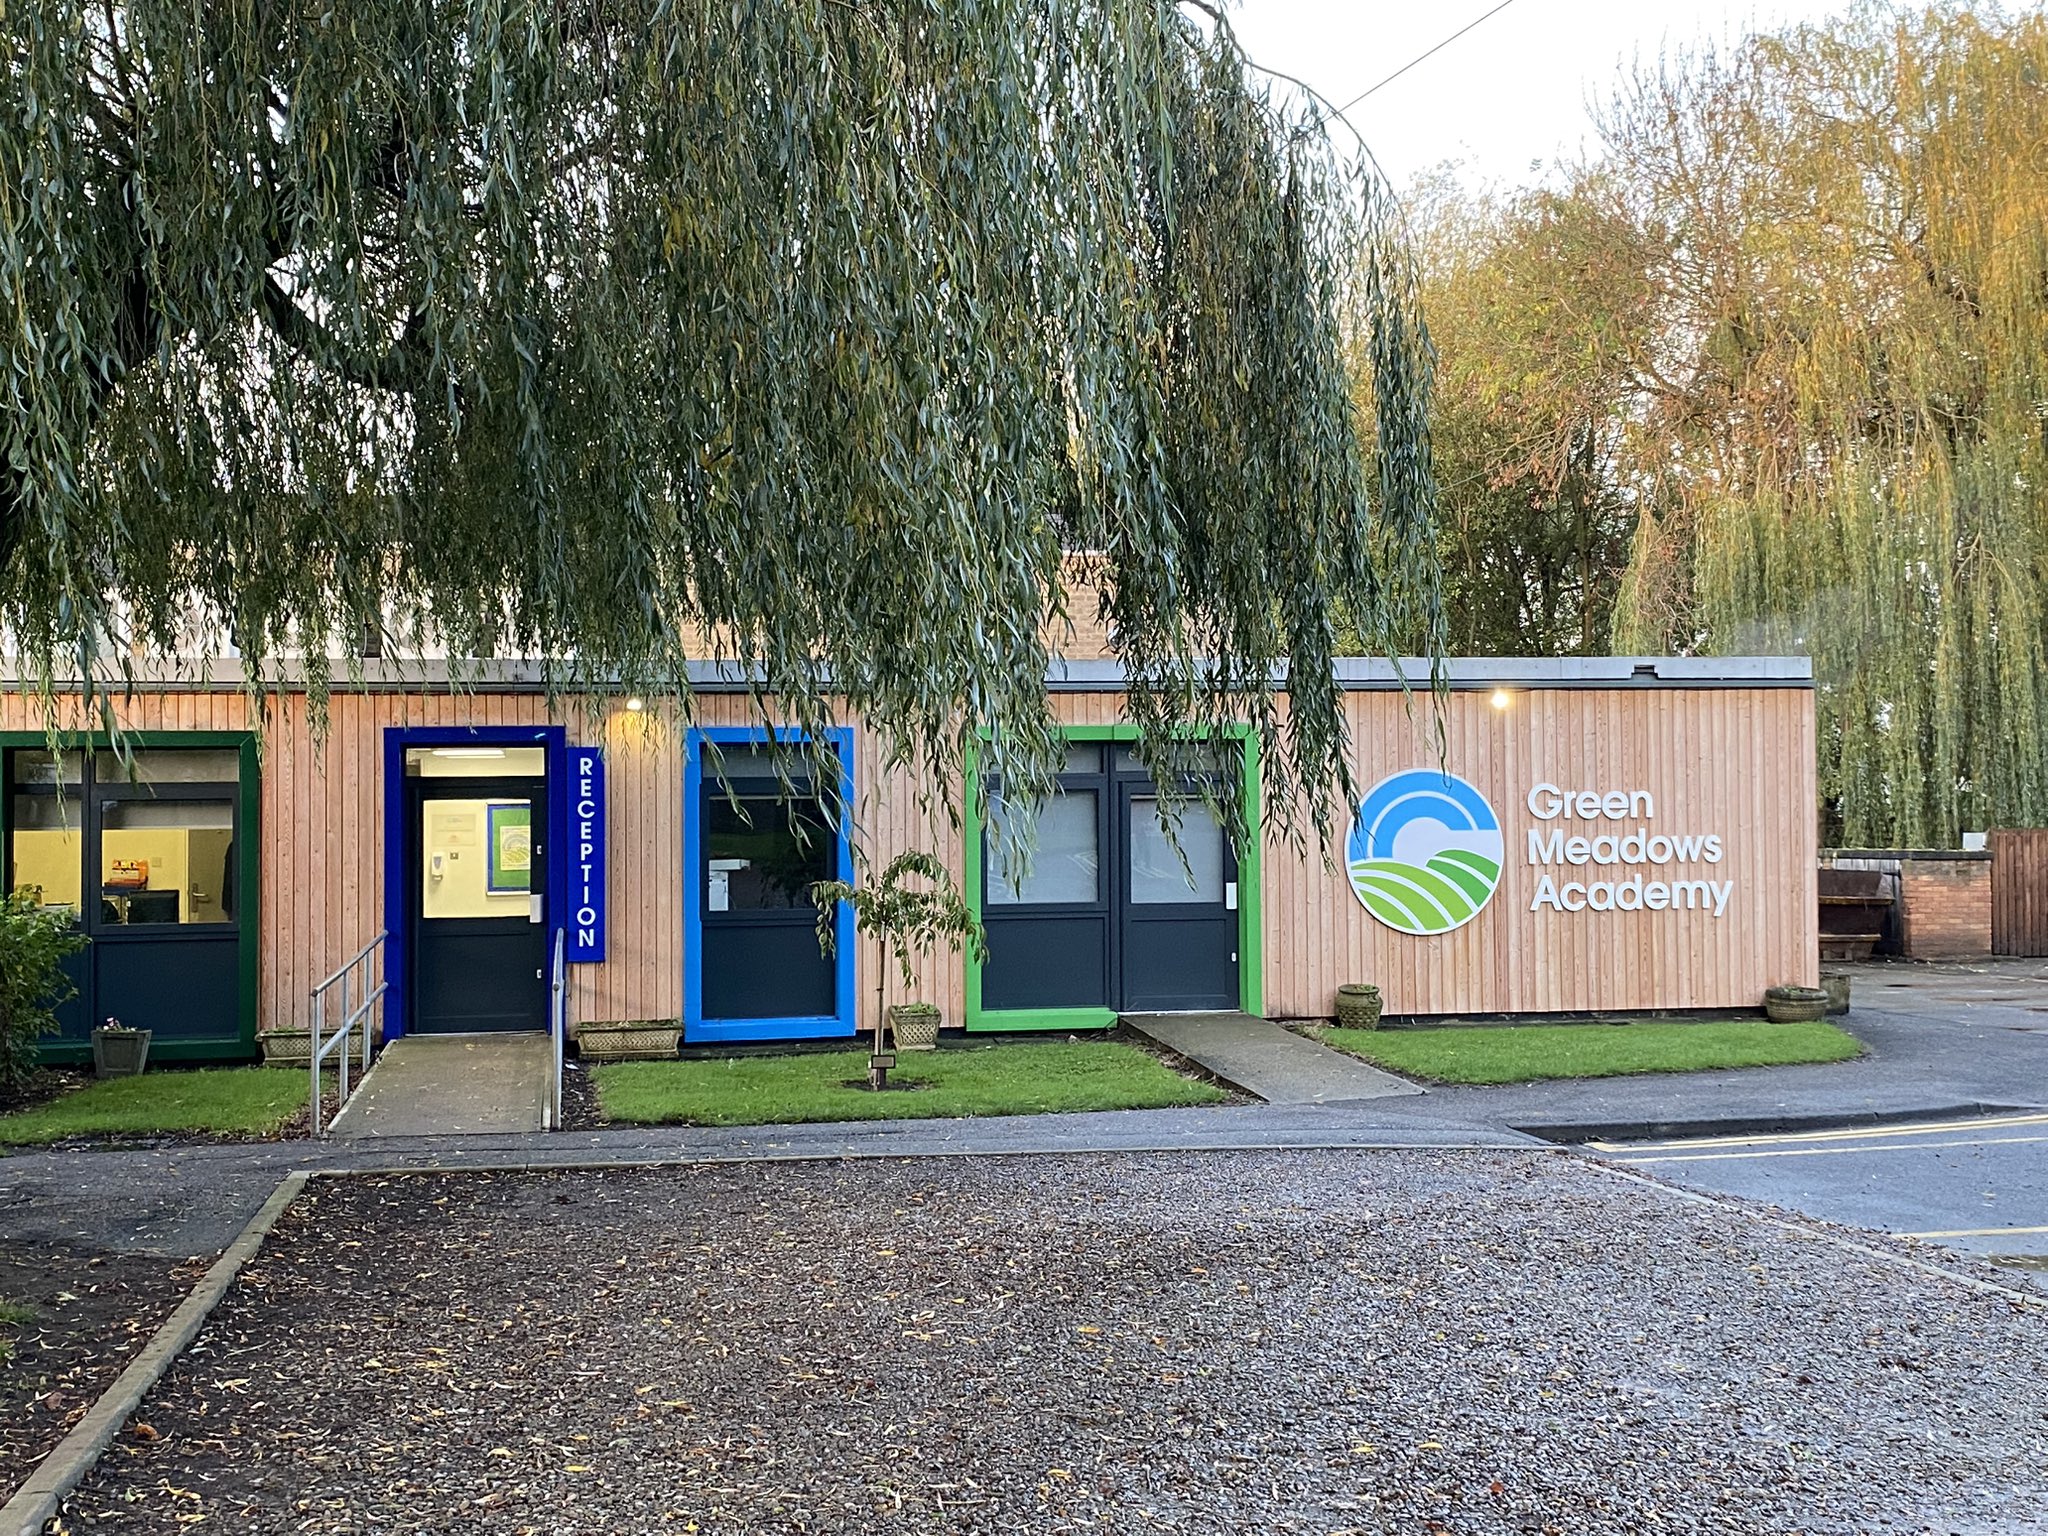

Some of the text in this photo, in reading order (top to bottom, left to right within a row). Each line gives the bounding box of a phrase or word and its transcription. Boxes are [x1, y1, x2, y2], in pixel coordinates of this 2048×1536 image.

[1527, 782, 1654, 820] Green
[577, 757, 596, 947] RECEPTION
[1527, 829, 1723, 865] Meadows
[1529, 874, 1734, 917] Academy
